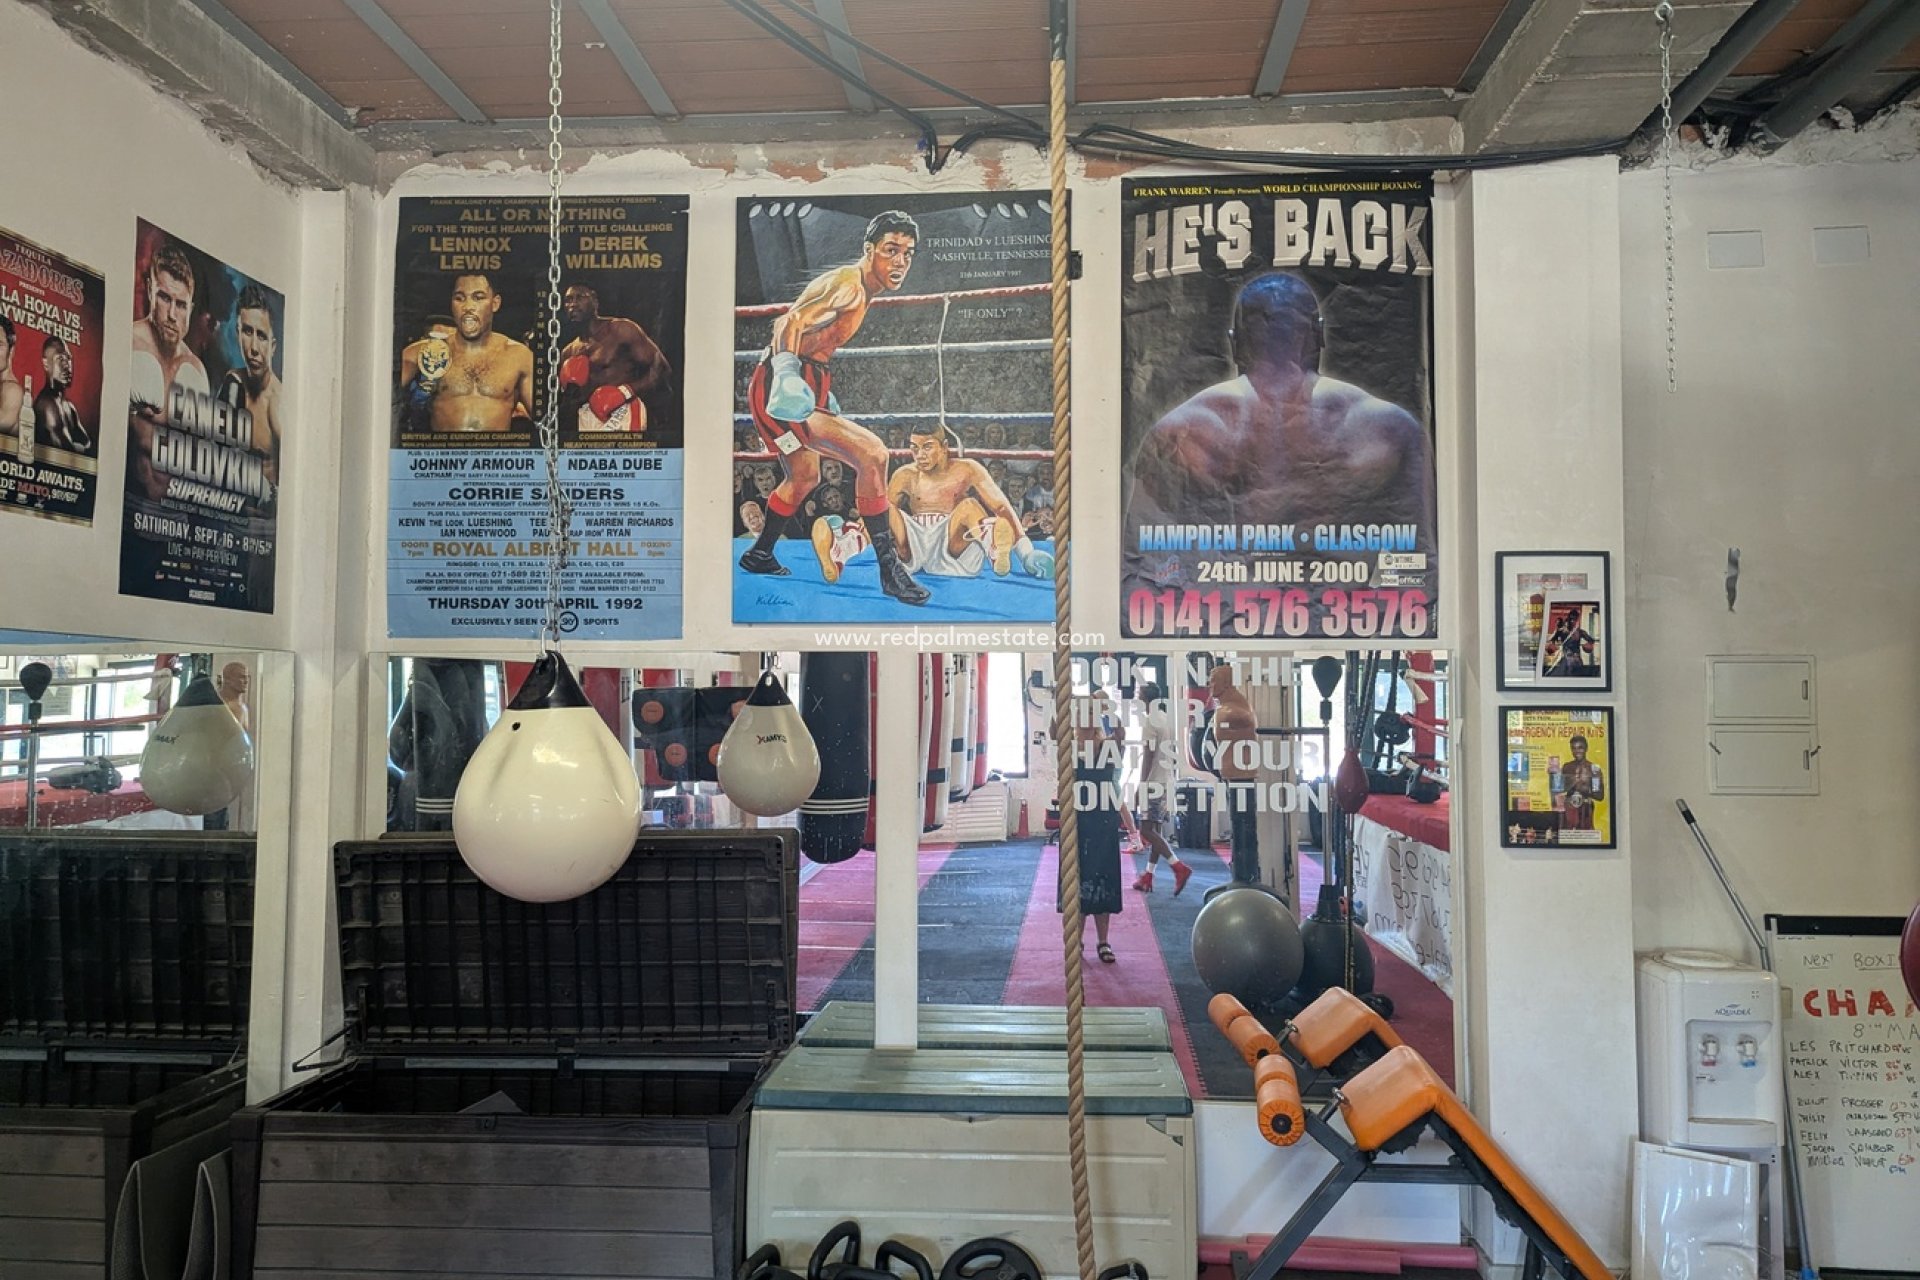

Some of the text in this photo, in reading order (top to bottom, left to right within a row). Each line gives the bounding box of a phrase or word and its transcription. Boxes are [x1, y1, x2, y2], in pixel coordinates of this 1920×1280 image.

[1133, 187, 1168, 197] FRANK
[1169, 186, 1212, 196] WARREN
[1213, 188, 1236, 196] Proudly
[1262, 184, 1301, 194] WORLD
[1302, 182, 1380, 193] CHAMPIONSHIP
[1381, 181, 1422, 190] BOXING
[460, 208, 496, 221] ALL
[503, 208, 531, 221] OR
[411, 223, 673, 234] FOR THE TRIPLE HEAVYWEHT TITLE CHALLENGE
[430, 237, 512, 252] LENNOX
[580, 236, 649, 251] DEREK
[926, 237, 983, 248] TRINIDAD
[1132, 198, 1433, 283] HE'S BACK
[15, 243, 52, 266] TEQUILA
[565, 253, 663, 269] WILLIAMS
[933, 250, 1053, 261] NASHVILLE, TENNESSEE
[440, 255, 502, 270] LEWIS
[974, 270, 1006, 278] JANUARY
[1, 284, 84, 331] LA HOYA VS.
[167, 382, 253, 451] CANELO
[491, 432, 531, 440] CHAMPION
[563, 441, 658, 449] HEAVYWEIGHT CHAMPION
[151, 424, 263, 497] GOLOVKIN
[409, 458, 535, 471] JOHNNY ARMOUR
[567, 458, 663, 471] NDABA DUBE
[36, 469, 85, 492] AWAITS.
[17, 481, 51, 500] MAYO,
[166, 477, 246, 514] SUPREMACY
[448, 488, 524, 500] CORRIE
[398, 518, 425, 527] KEVIN
[430, 519, 442, 527] THE
[445, 519, 463, 527] LOOK
[467, 518, 513, 527] LUESHING
[529, 518, 547, 527] TEE
[584, 518, 624, 527] WARREN
[627, 518, 674, 527] RICHARDS
[133, 512, 192, 542] SATURDAY,
[194, 525, 221, 547] SEPT.
[222, 532, 234, 549] 16
[440, 528, 631, 538] IAN HONEYWOOD PAU RYAN
[1139, 523, 1418, 551] HAMPDEN PARK GLASGOW
[167, 542, 183, 558] LIVE
[433, 542, 498, 557] ROYAL
[504, 542, 580, 557] ALBT
[587, 542, 638, 556] HALL
[1197, 560, 1248, 583] 24th
[1252, 560, 1304, 583] JUNE
[1309, 560, 1369, 583] 2000
[428, 597, 644, 610] THURSDAY 30th APRIL 1992
[1129, 586, 1221, 636] 0141
[1233, 586, 1310, 636] 576
[1321, 586, 1428, 636] 3576
[451, 618, 512, 626] EXCLUSIVELY
[513, 618, 538, 626] SEEN
[583, 618, 620, 626] SPORTS
[1166, 657, 1207, 687] IN
[1223, 657, 1304, 687] THE
[1508, 727, 1556, 738] EMERGENCY
[1558, 726, 1585, 738] REPAIR
[1207, 740, 1320, 770] YOUR
[1853, 952, 1899, 968] BOXI
[1789, 1041, 1816, 1052] LES
[1829, 1040, 1891, 1053] PRITCHARD
[1789, 1057, 1829, 1067] PATRICK
[1840, 1057, 1879, 1069] VICTOR
[1793, 1070, 1820, 1080] ALEX
[1801, 1130, 1828, 1141] FELIX
